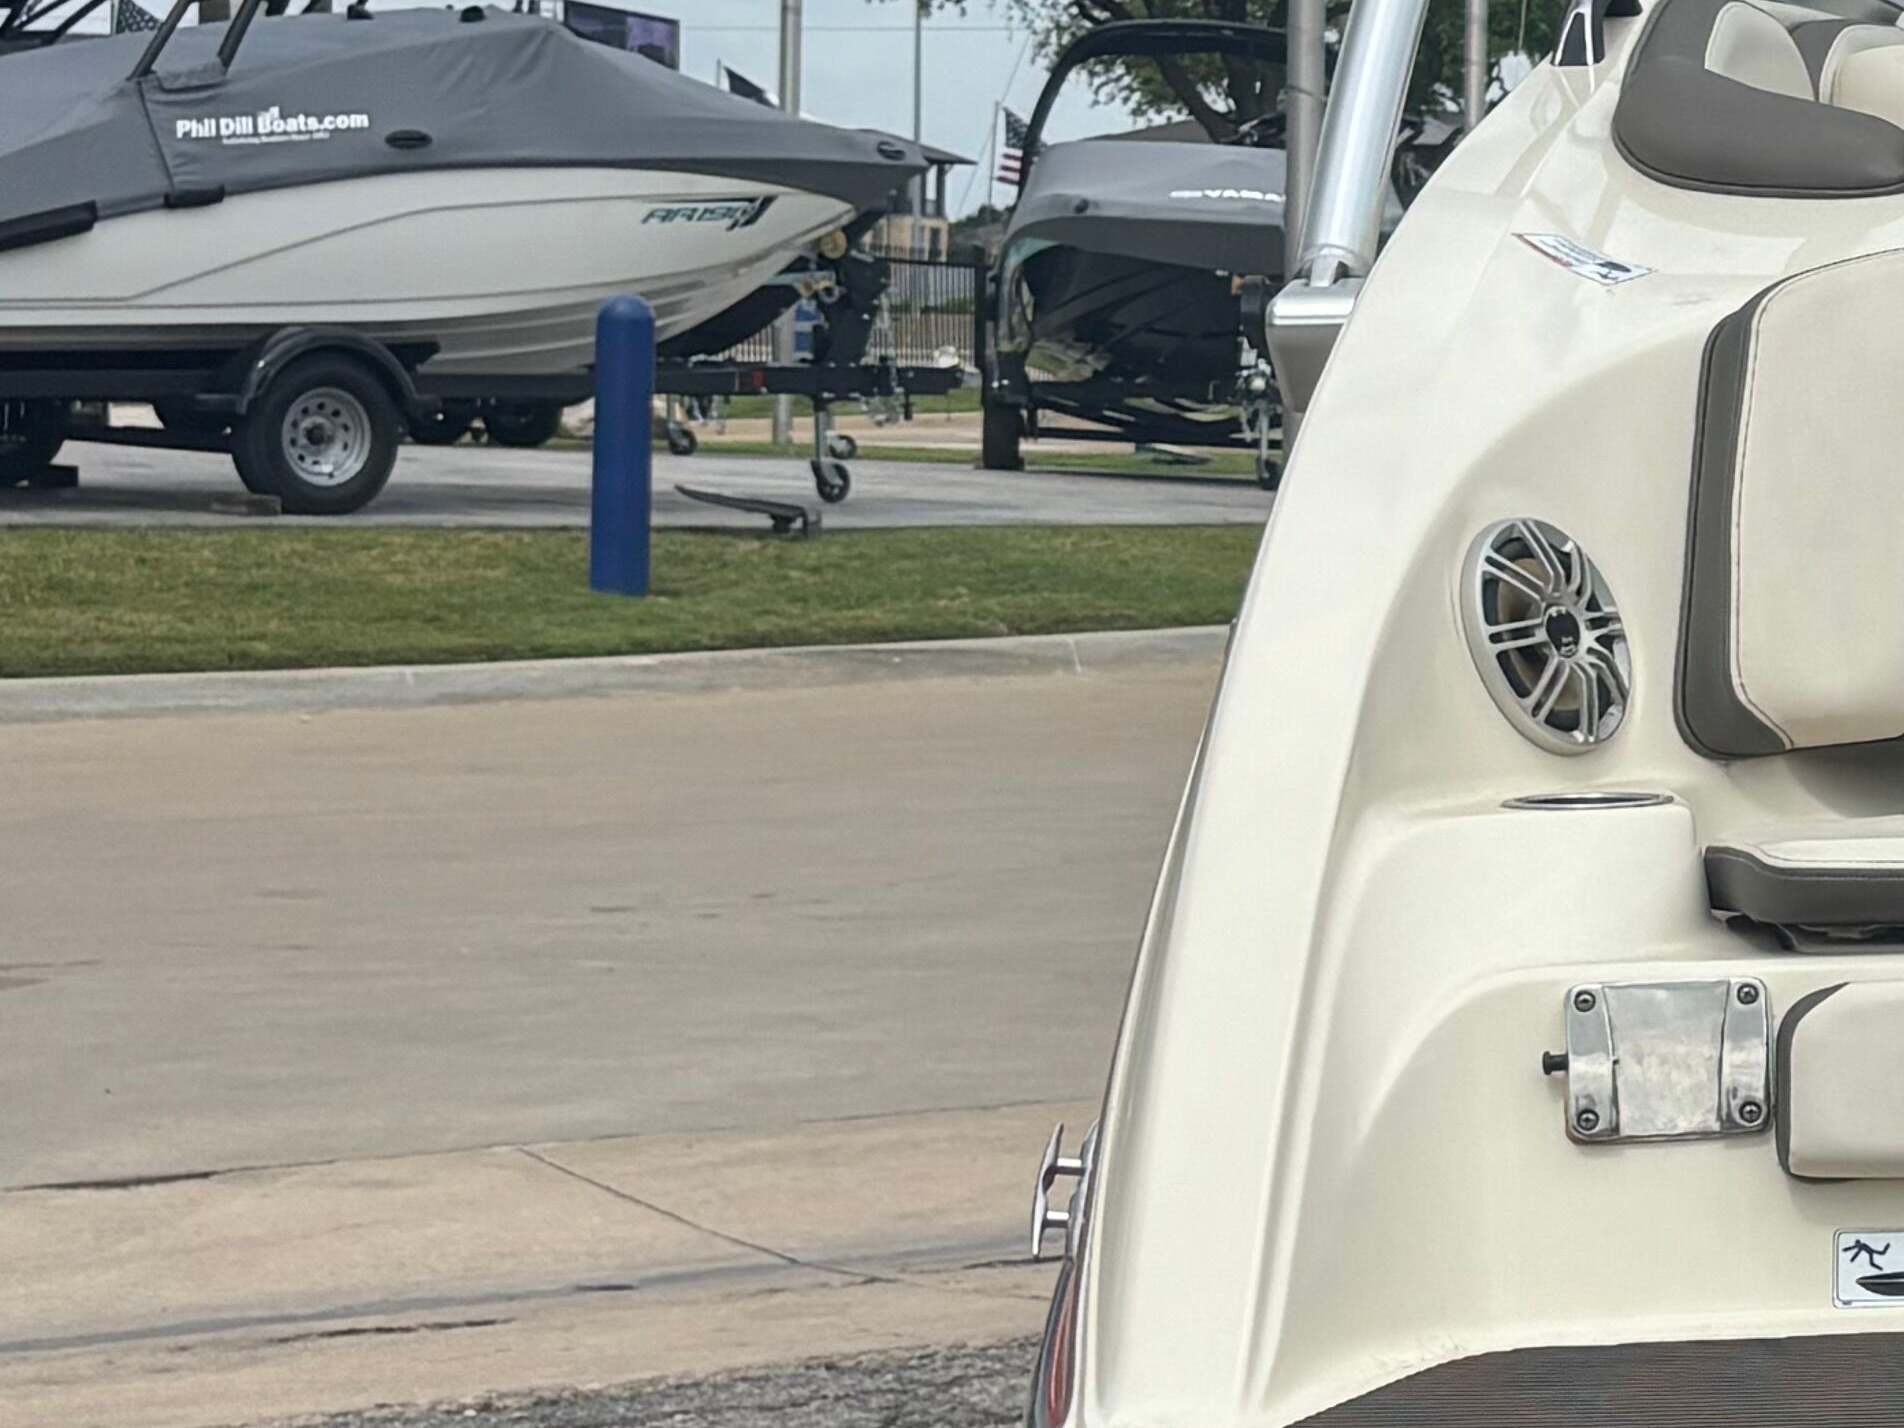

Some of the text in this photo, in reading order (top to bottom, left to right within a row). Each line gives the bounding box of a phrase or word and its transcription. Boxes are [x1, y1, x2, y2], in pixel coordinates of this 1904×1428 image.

[176, 118, 216, 139] Phil
[219, 116, 254, 136] Dill
[257, 113, 369, 134] Boats.com
